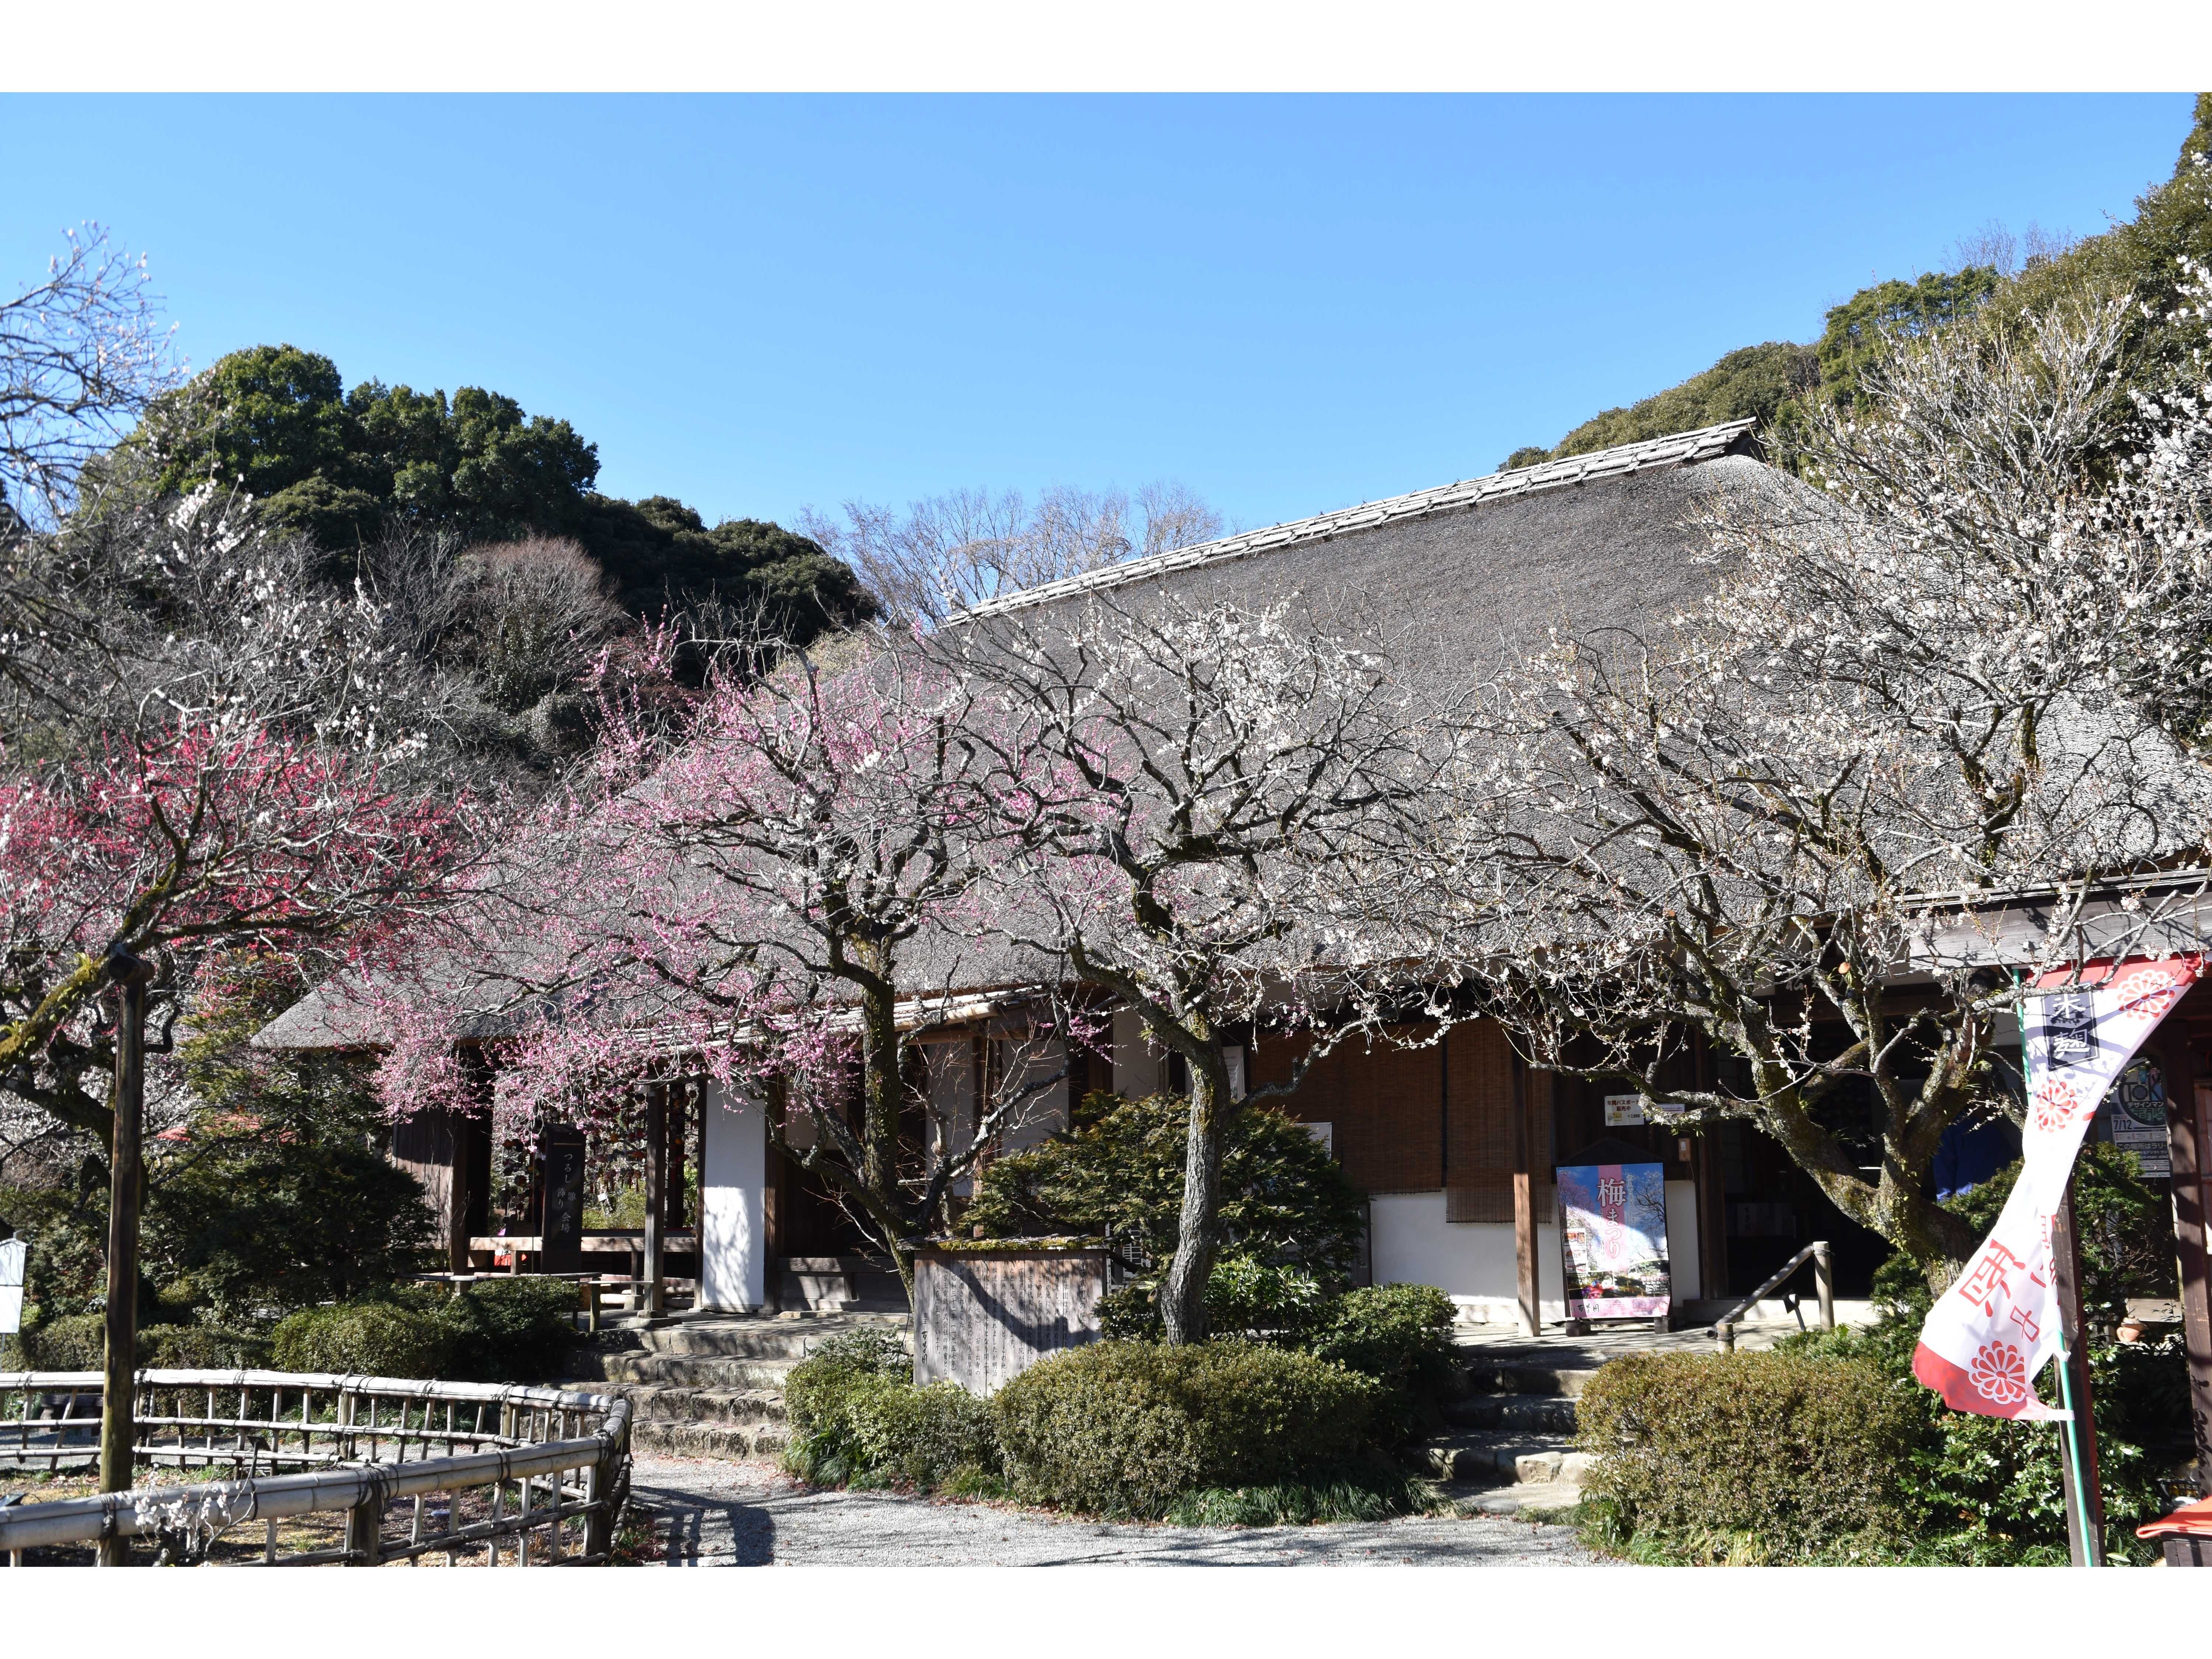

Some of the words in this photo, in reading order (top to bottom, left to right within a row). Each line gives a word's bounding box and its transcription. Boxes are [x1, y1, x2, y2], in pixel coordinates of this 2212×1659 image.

[2114, 1120, 2132, 1130] 7/12
[1596, 1178, 1627, 1259] 梅まつり
